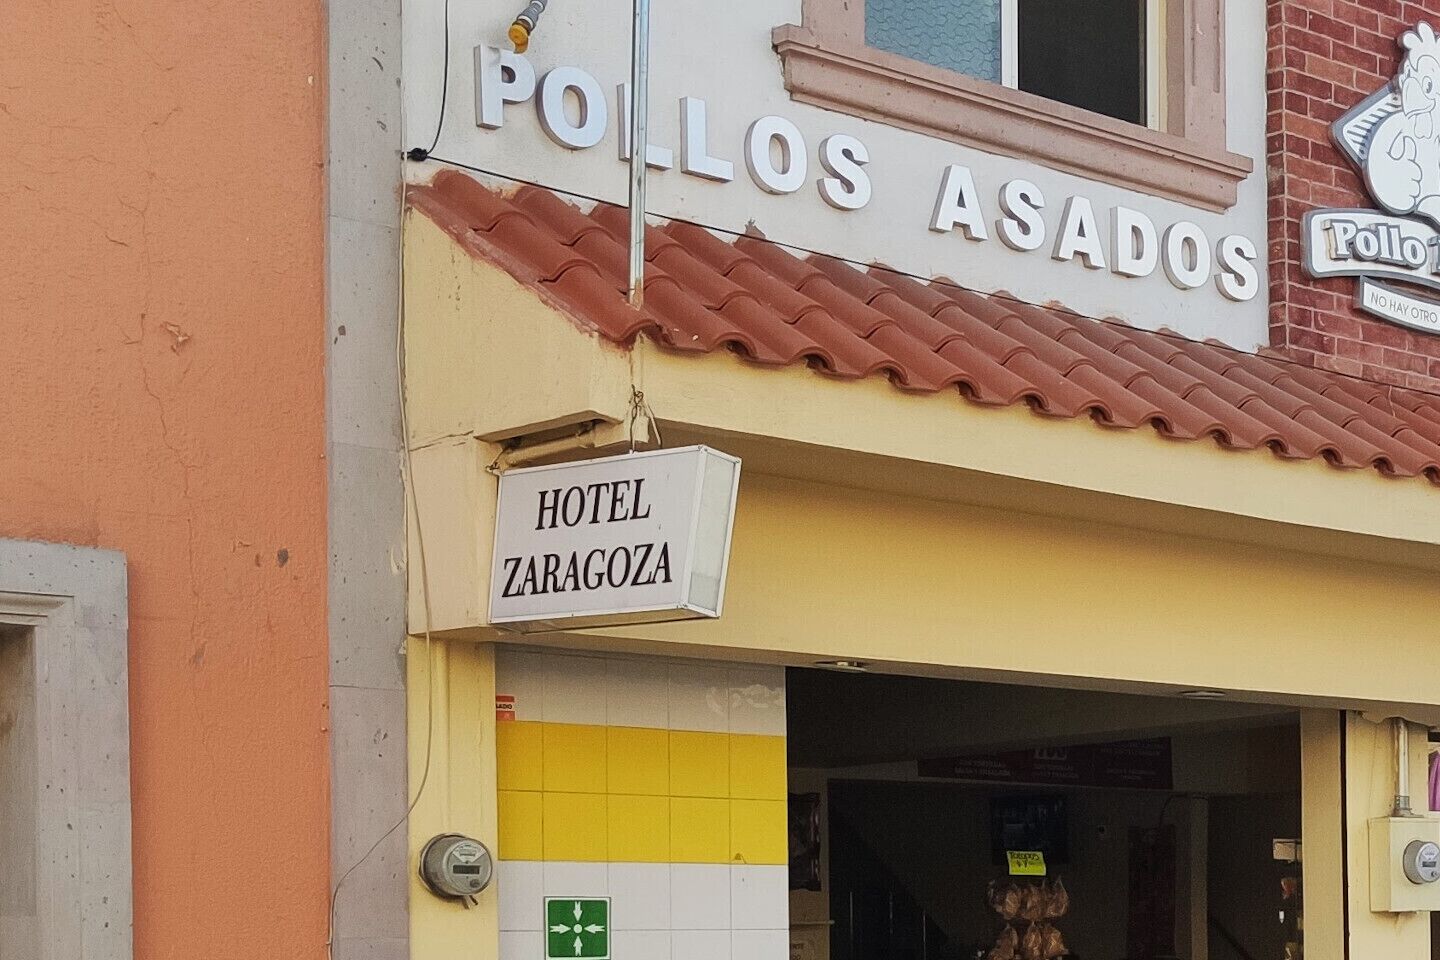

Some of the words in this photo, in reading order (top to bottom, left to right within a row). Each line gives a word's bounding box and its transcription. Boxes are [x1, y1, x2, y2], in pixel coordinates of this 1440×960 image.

[474, 43, 873, 212] POLLOS
[928, 163, 1260, 302] ASADOS
[1322, 217, 1428, 270] Pollo
[1370, 290, 1387, 308] NO
[1389, 299, 1409, 316] HAY
[1410, 307, 1438, 323] OTRO
[535, 478, 652, 531] HOTEL
[501, 541, 673, 598] ZARAGOZA
